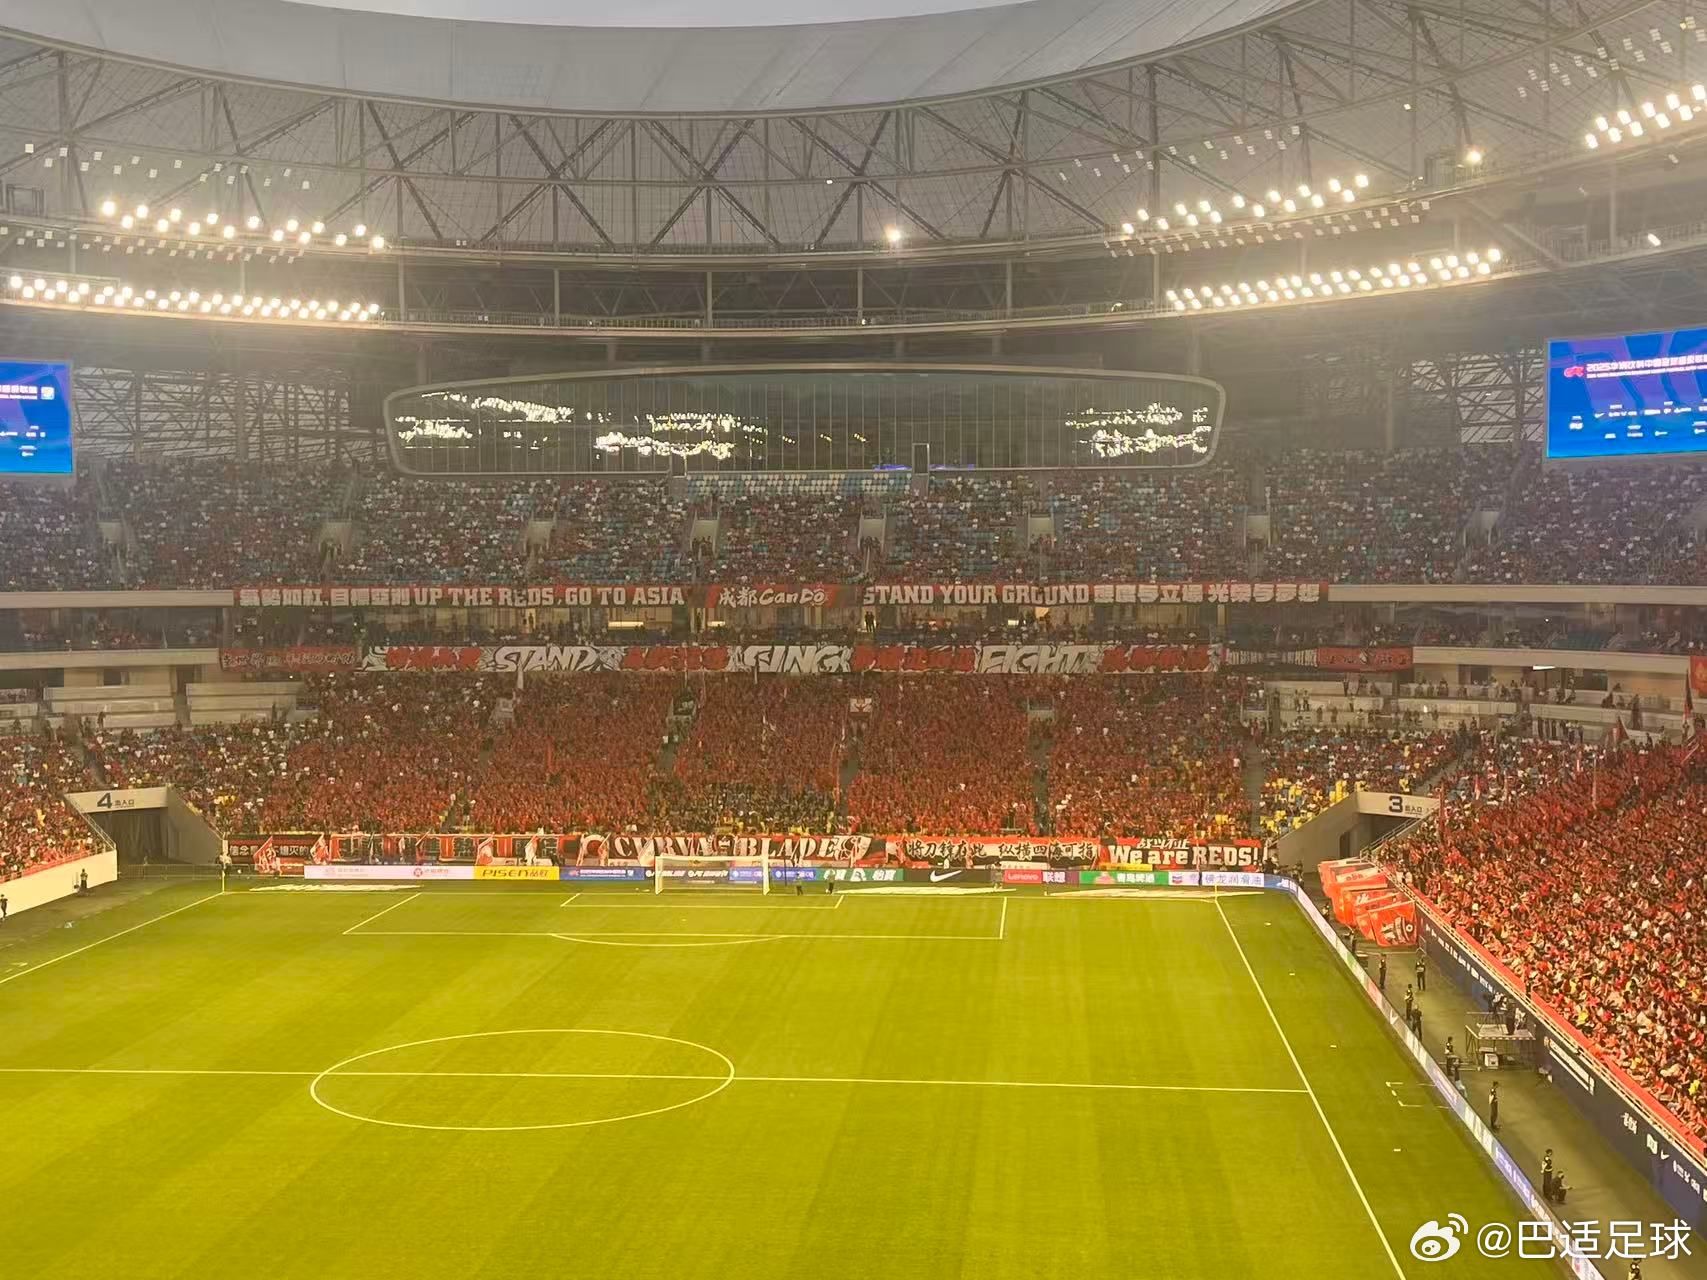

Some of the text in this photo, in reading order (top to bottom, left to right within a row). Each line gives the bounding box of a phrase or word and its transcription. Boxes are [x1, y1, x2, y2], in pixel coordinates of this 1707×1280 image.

[414, 587, 442, 605] UP
[448, 587, 493, 606] THE
[597, 587, 626, 605] TO
[632, 587, 685, 605] ASIA
[863, 585, 934, 605] STAND
[940, 585, 998, 604] YOUR
[494, 646, 598, 672] STAND
[982, 645, 1095, 673] FIGHT
[97, 792, 112, 808] 4
[1389, 795, 1403, 813] 3
[1108, 845, 1143, 864] We
[1147, 850, 1189, 865] are
